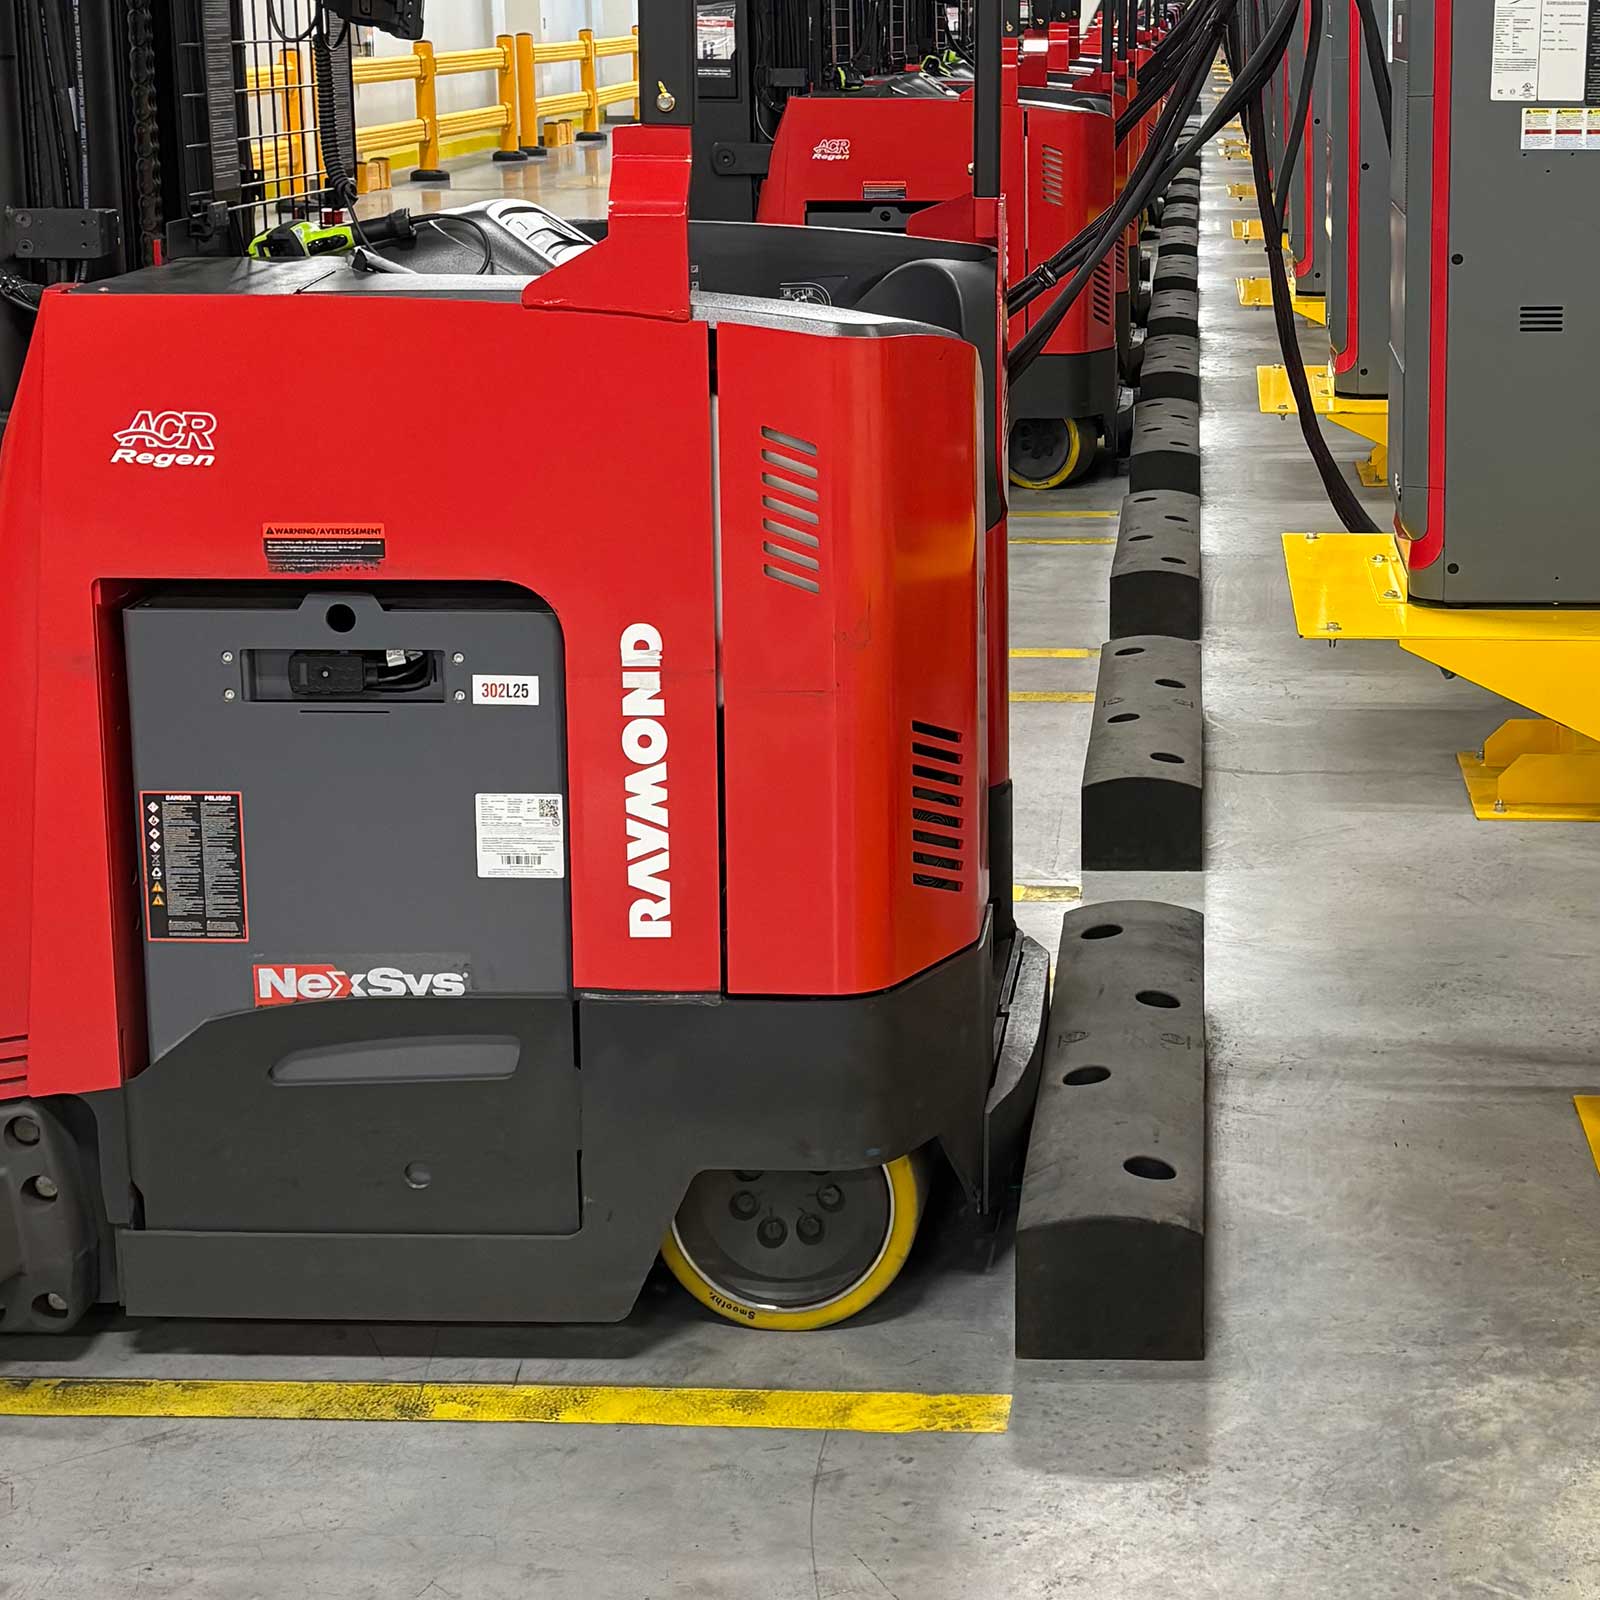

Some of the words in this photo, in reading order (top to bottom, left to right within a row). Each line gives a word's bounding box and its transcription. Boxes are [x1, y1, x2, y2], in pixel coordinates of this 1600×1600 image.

[813, 139, 850, 154] ACR
[113, 411, 217, 450] ACR
[110, 448, 215, 468] Regen
[481, 683, 529, 698] 302L25
[619, 622, 672, 939] RAYMOND
